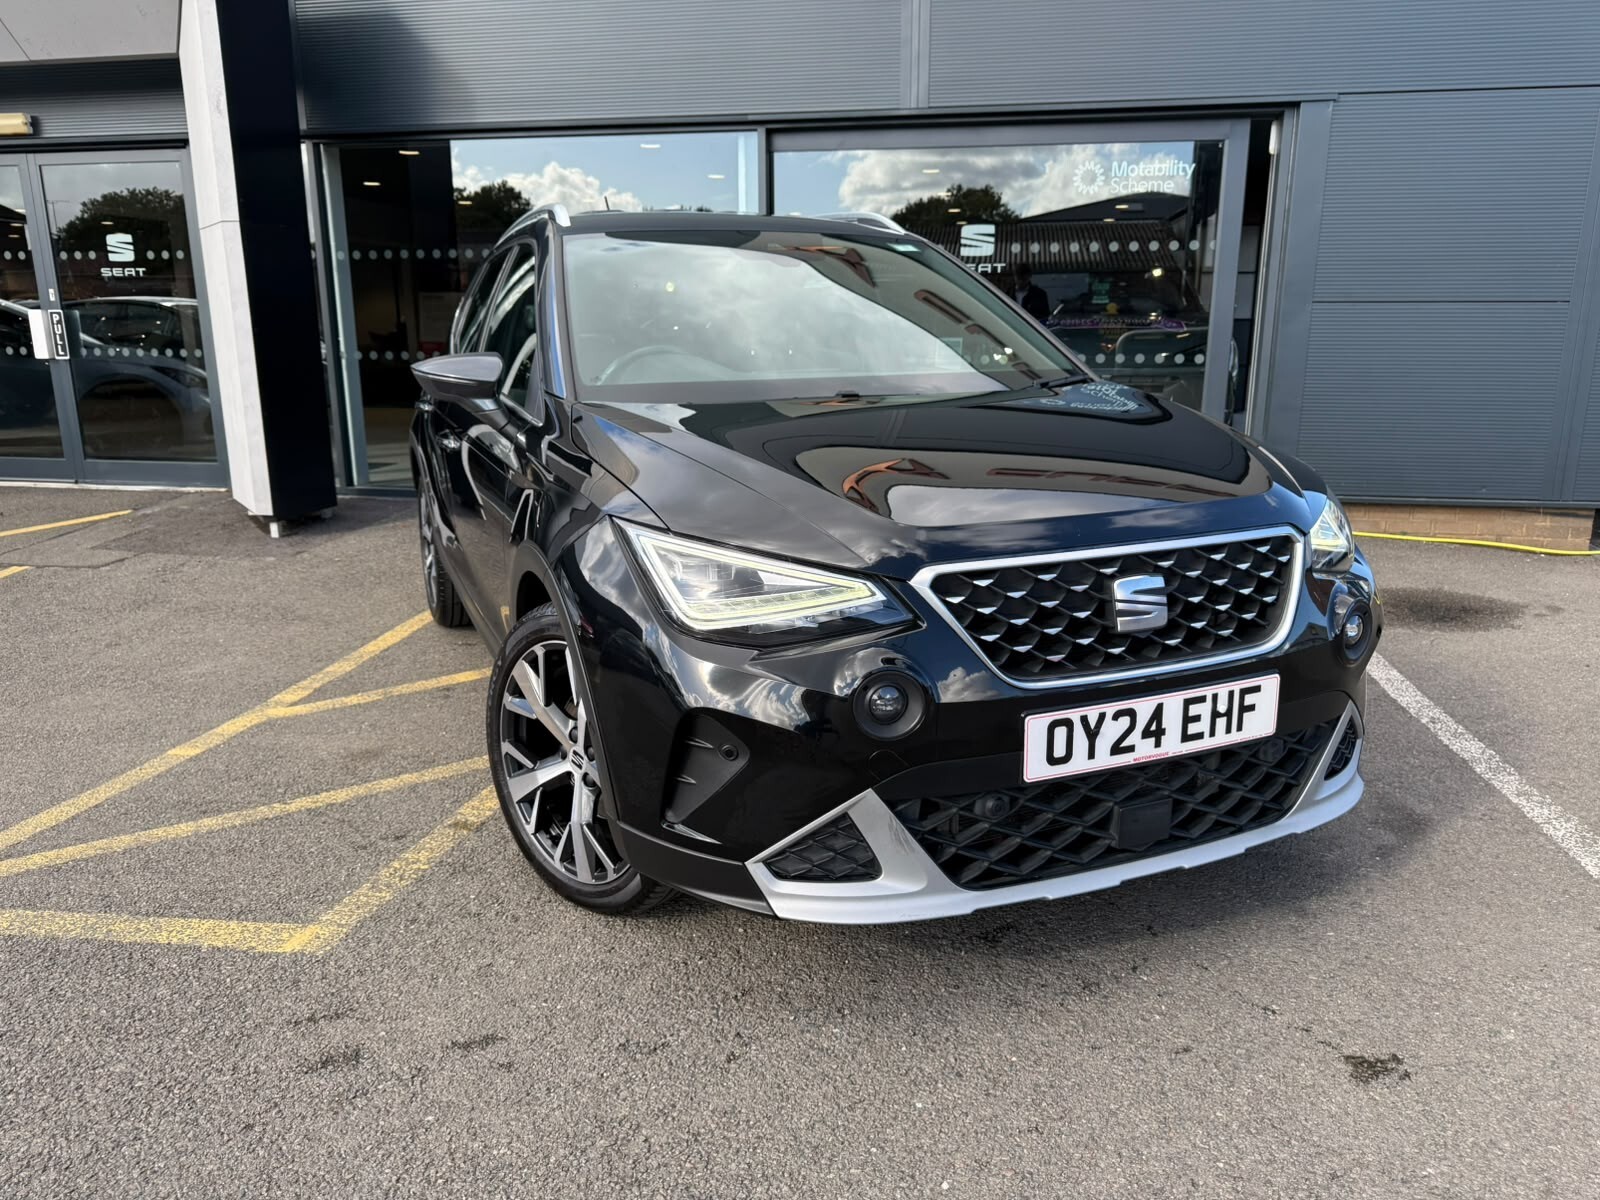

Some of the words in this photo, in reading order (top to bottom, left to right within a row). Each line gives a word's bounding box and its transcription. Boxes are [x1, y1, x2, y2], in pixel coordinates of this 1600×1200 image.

[1111, 159, 1196, 180] Motability
[1110, 178, 1175, 193] Scheme
[100, 267, 147, 277] SEAT
[966, 263, 1006, 273] EAT
[52, 313, 65, 356] PULL
[1046, 702, 1167, 767] OY24
[1181, 684, 1262, 744] EHF
